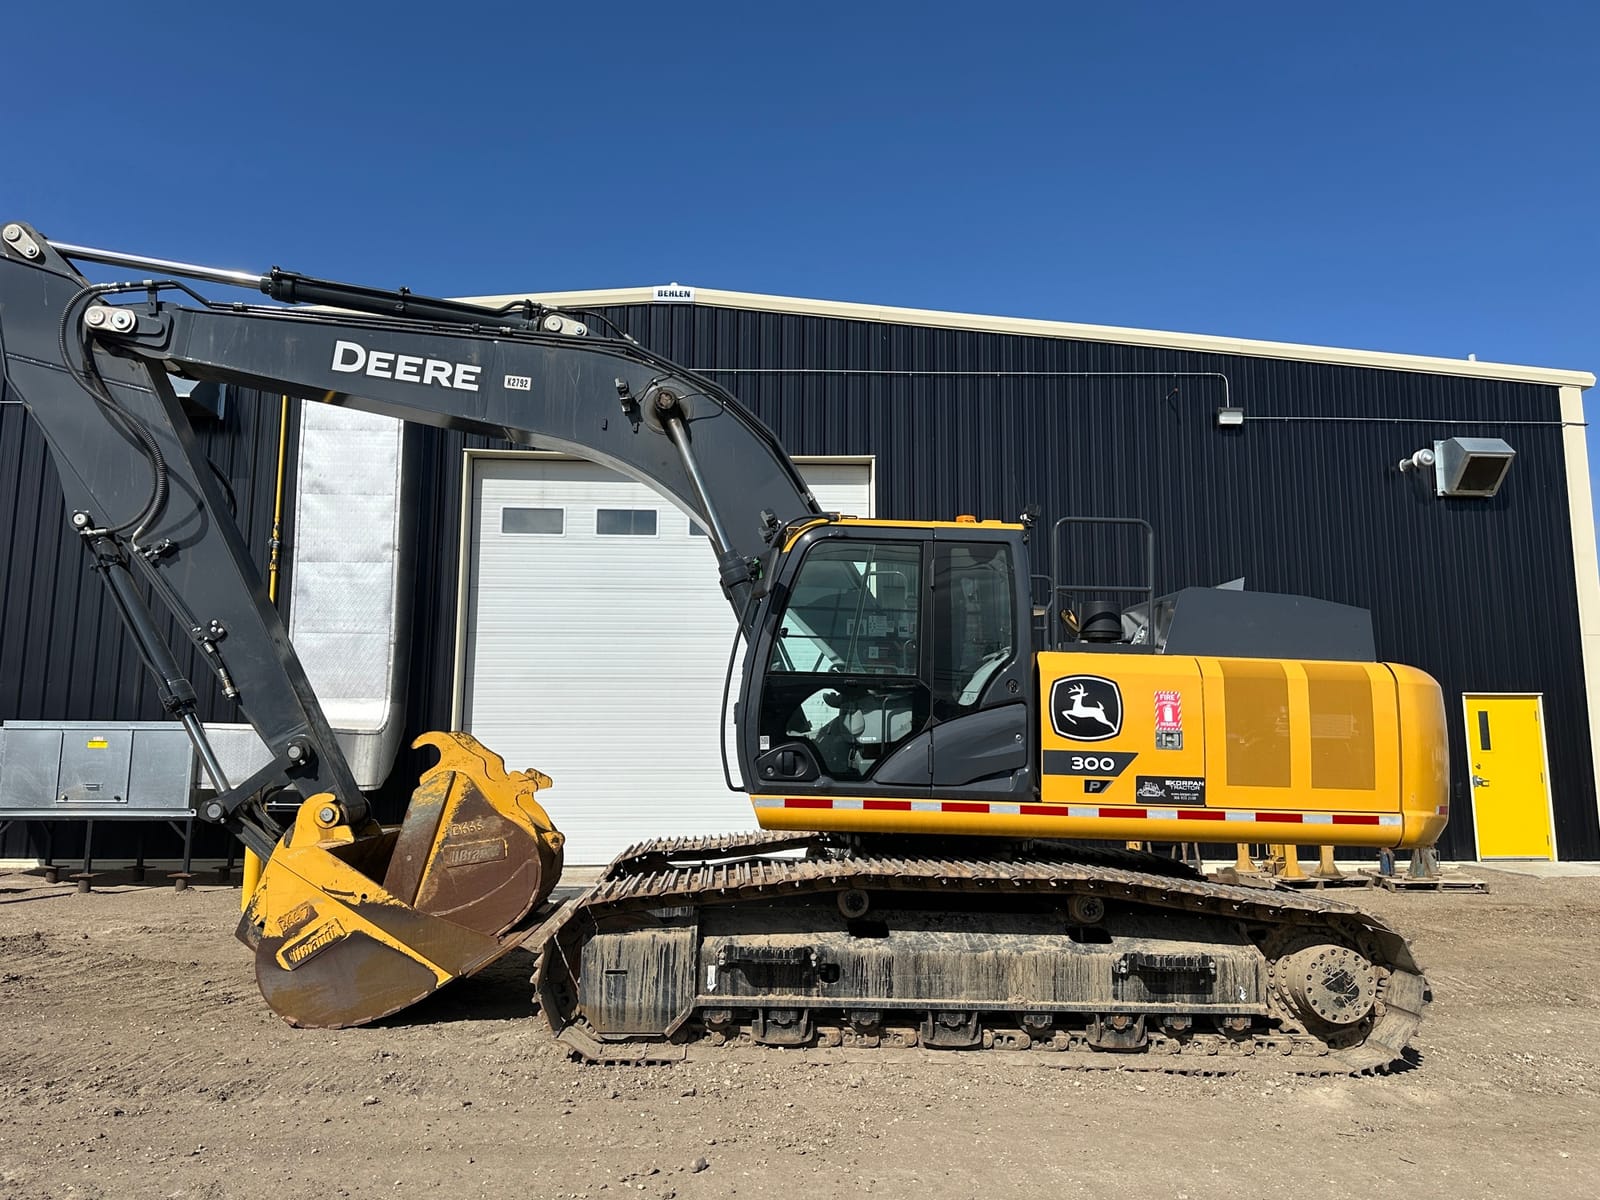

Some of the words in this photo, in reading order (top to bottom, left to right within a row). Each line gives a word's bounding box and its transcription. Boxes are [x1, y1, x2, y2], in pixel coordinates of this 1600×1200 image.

[657, 289, 691, 297] BEHLEN
[331, 340, 482, 392] DEERE
[507, 377, 528, 388] K2792
[1071, 756, 1115, 771] 300
[1089, 781, 1101, 792] P
